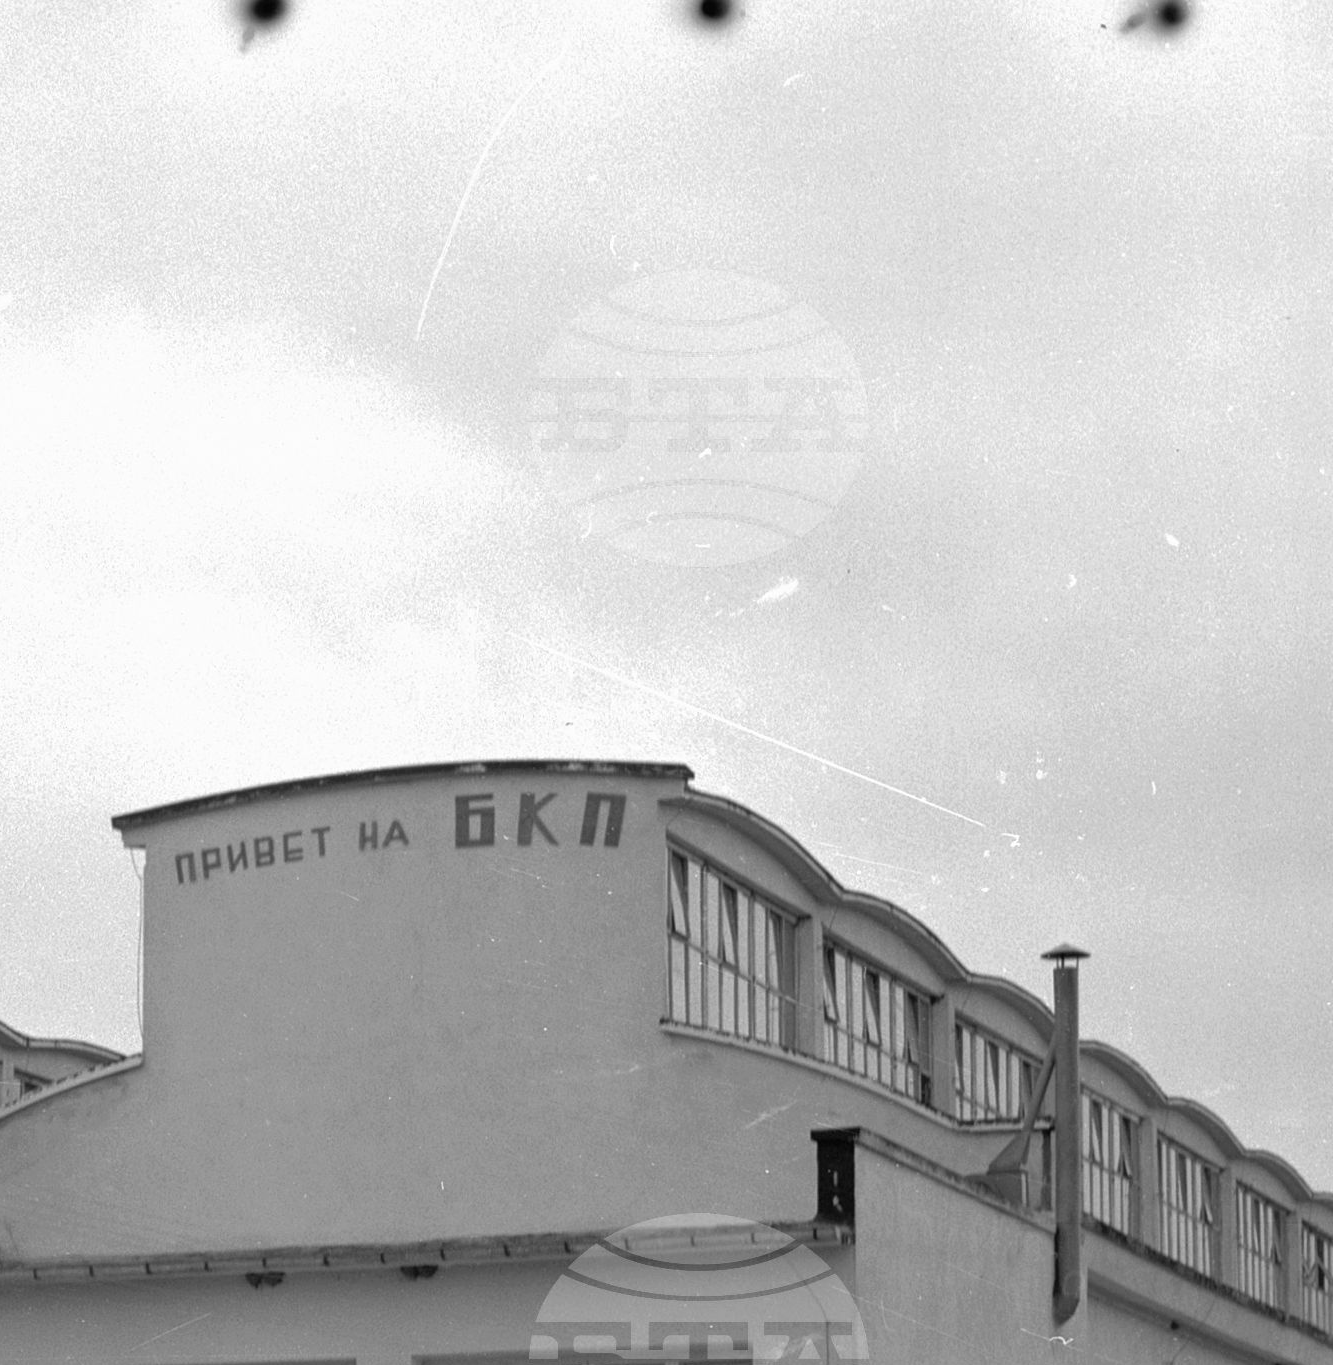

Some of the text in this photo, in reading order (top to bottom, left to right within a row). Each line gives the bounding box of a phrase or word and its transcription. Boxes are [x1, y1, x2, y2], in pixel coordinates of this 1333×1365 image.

[174, 791, 628, 885] ПРИВЕТ НА БКП
